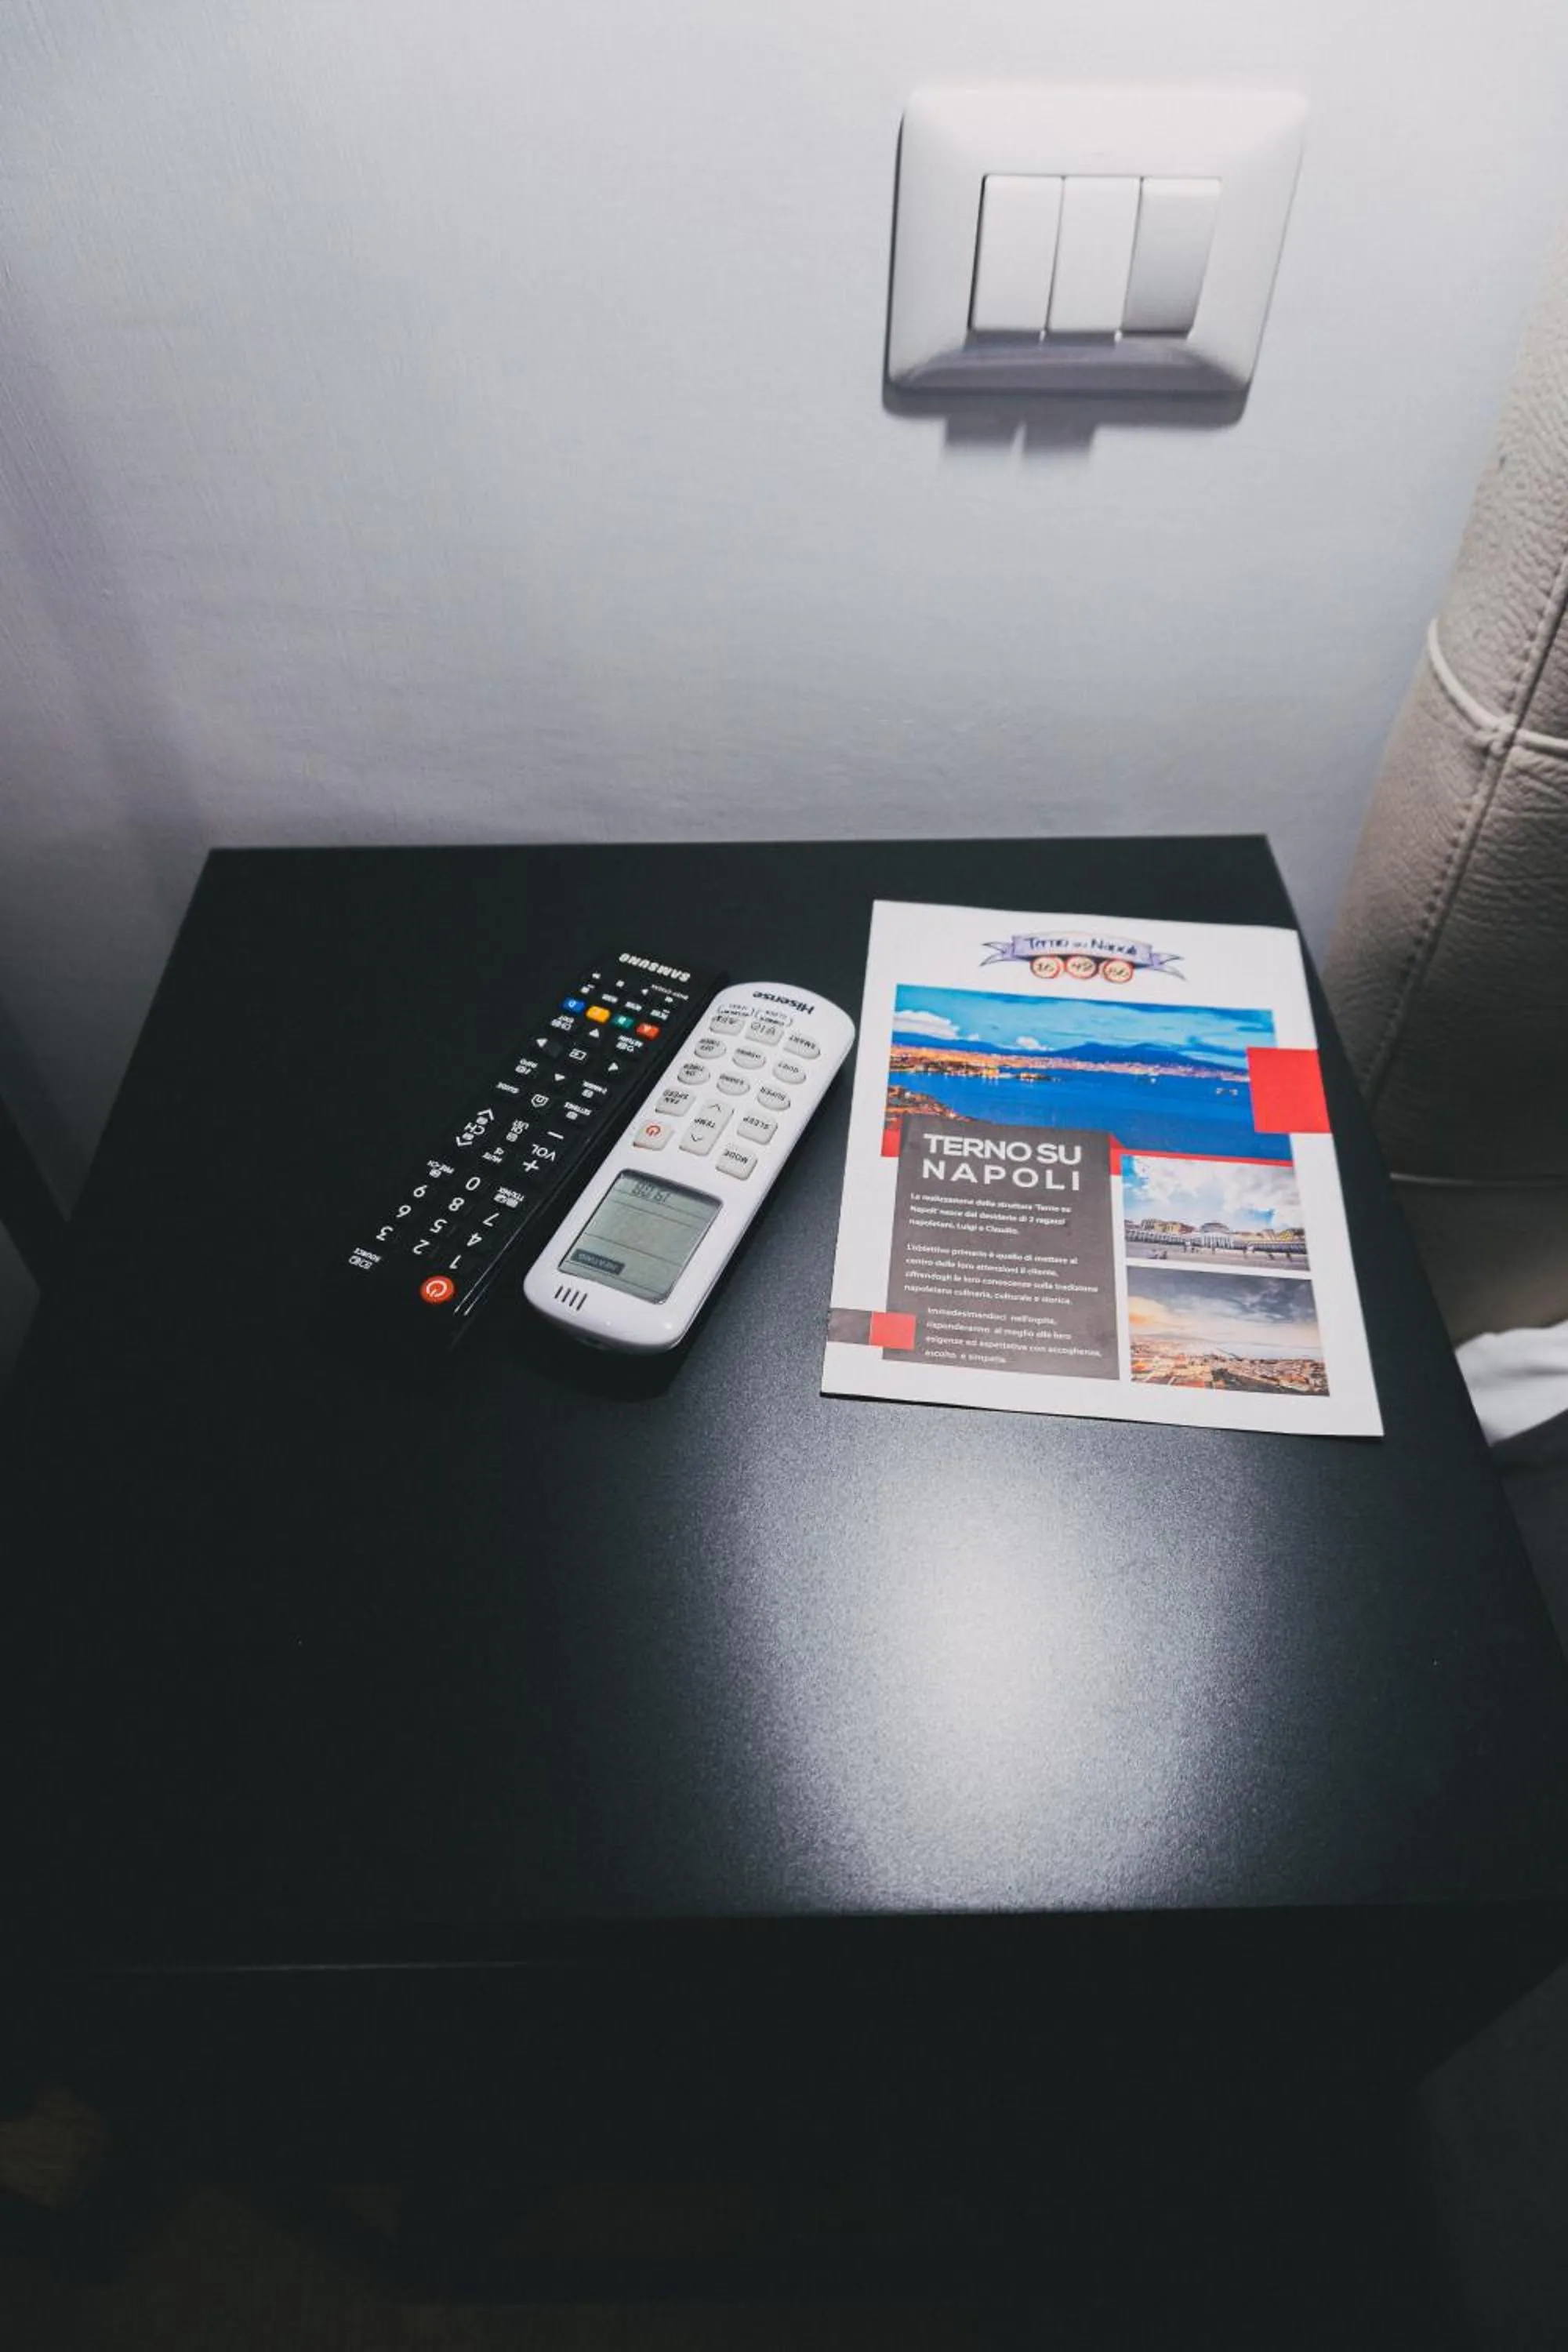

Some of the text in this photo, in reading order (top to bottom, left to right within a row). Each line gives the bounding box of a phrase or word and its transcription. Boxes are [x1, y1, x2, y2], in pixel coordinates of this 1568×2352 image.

[619, 953, 691, 982] SAMSUNG
[753, 991, 815, 1014] Hisense
[464, 1122, 485, 1134] CH
[694, 1118, 716, 1128] TEMP
[742, 1116, 770, 1130] SLEEP
[532, 1144, 556, 1162] VOL
[724, 1149, 749, 1164] MODE
[924, 1134, 1081, 1165] TERNO SU
[923, 1159, 1080, 1191] NAPOLI
[466, 1177, 481, 1191] 0
[413, 1185, 429, 1198] 9
[396, 1204, 412, 1218] 6
[448, 1197, 464, 1211] 8
[430, 1219, 448, 1233] 5
[482, 1213, 499, 1227] 7
[956, 1221, 978, 1232] Luigi
[376, 1225, 394, 1241] 3
[466, 1232, 482, 1247] 4
[413, 1240, 430, 1254] 2
[449, 1254, 461, 1269] 1
